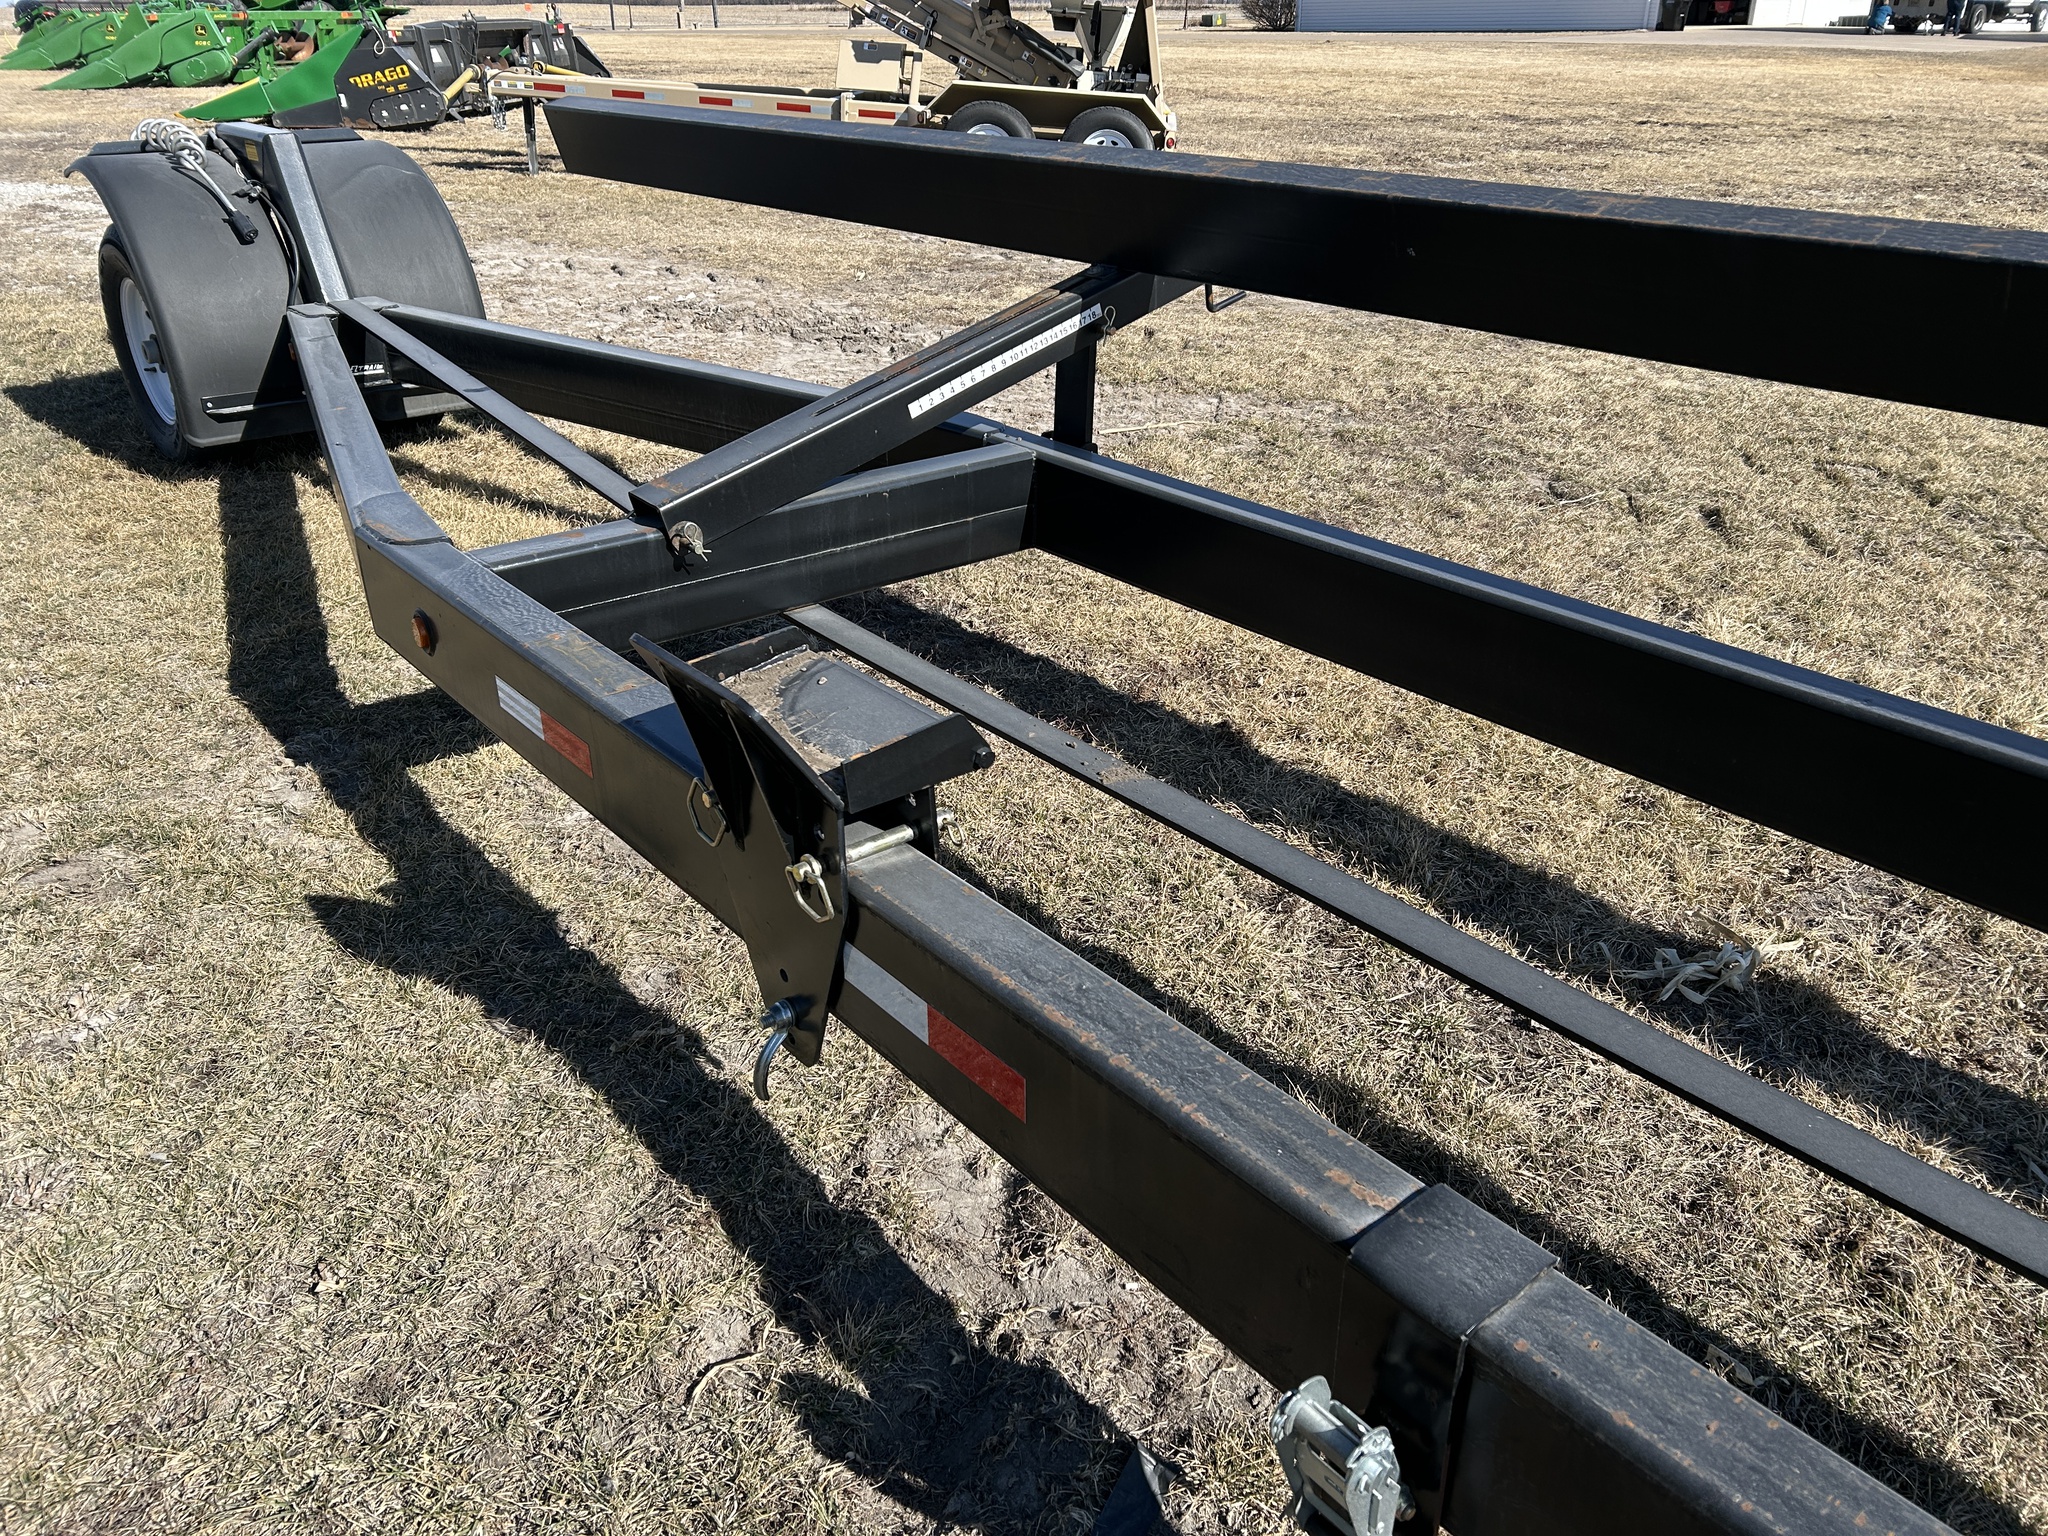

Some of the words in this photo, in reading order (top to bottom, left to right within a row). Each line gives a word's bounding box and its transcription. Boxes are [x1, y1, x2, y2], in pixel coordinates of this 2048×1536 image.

[929, 398, 934, 406] 2
[939, 392, 945, 400] 3
[970, 375, 976, 383] 6
[980, 369, 986, 377] 7
[991, 364, 996, 372] 8
[1001, 359, 1007, 367] 9
[1010, 353, 1018, 361] 10
[1020, 348, 1028, 356] 11
[1030, 342, 1038, 351] 12
[1040, 337, 1048, 346] 13
[1050, 332, 1058, 341] 14
[1059, 327, 1068, 336] 15
[1069, 322, 1077, 330] 16
[1079, 316, 1086, 326] 17
[1088, 311, 1096, 320] 18
